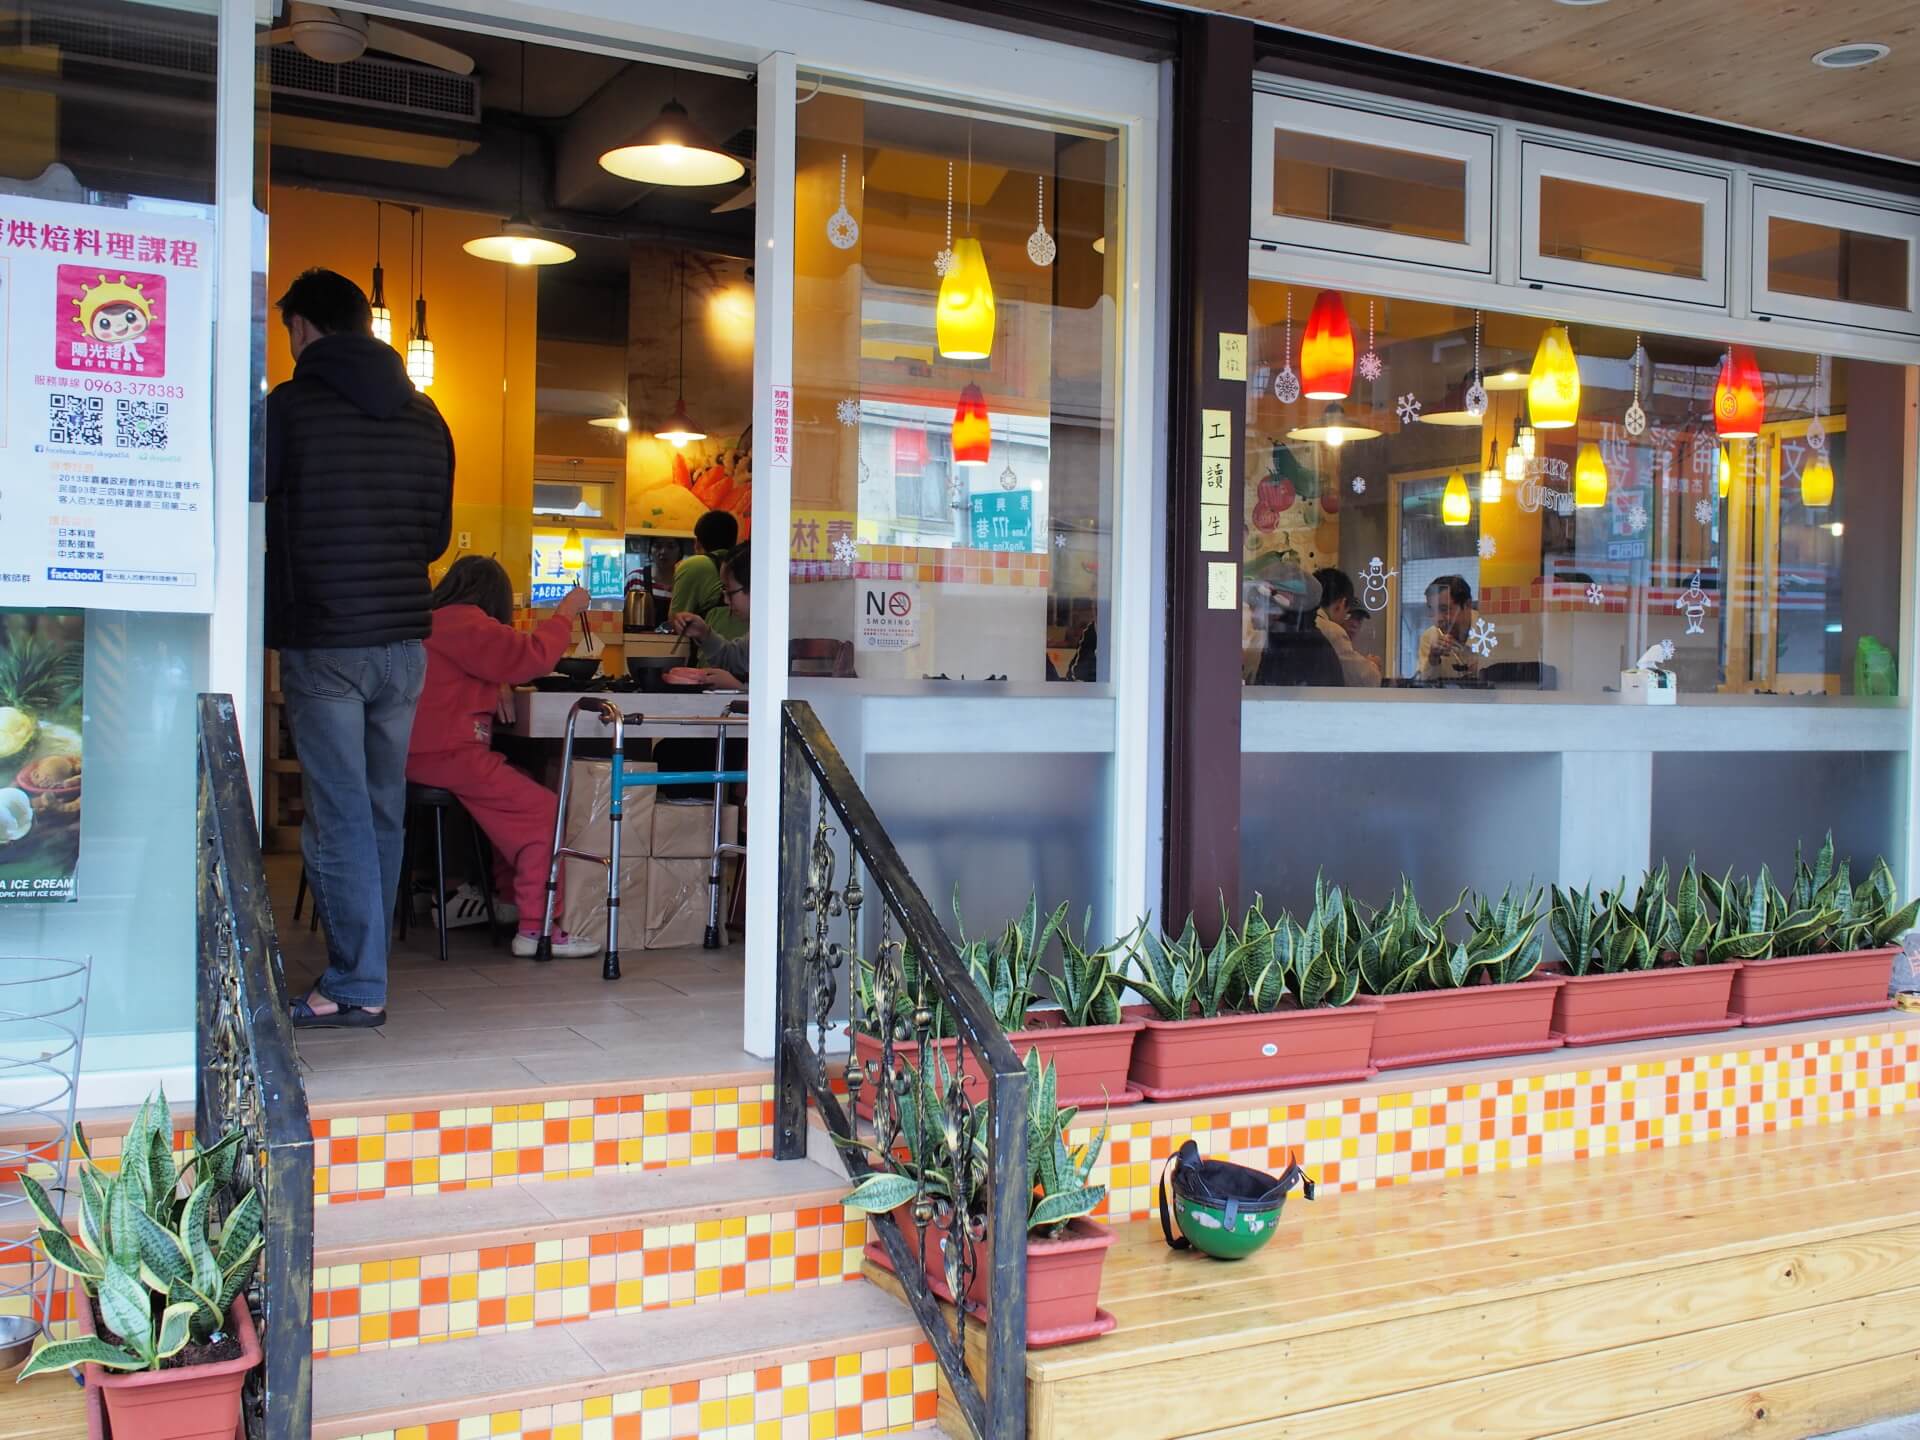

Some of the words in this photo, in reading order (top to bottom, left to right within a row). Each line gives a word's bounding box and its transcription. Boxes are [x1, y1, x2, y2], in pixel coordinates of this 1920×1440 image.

[0, 218, 198, 268] 烘焙料理課程
[84, 378, 184, 399] 0963-378383
[1207, 423, 1224, 537] 工讀生
[58, 528, 96, 538] 日本料理
[0, 572, 32, 583] 教師群
[50, 568, 102, 582] facebook
[866, 618, 911, 626] SMOKING
[10, 879, 30, 889] ICE
[33, 879, 74, 889] CREAM
